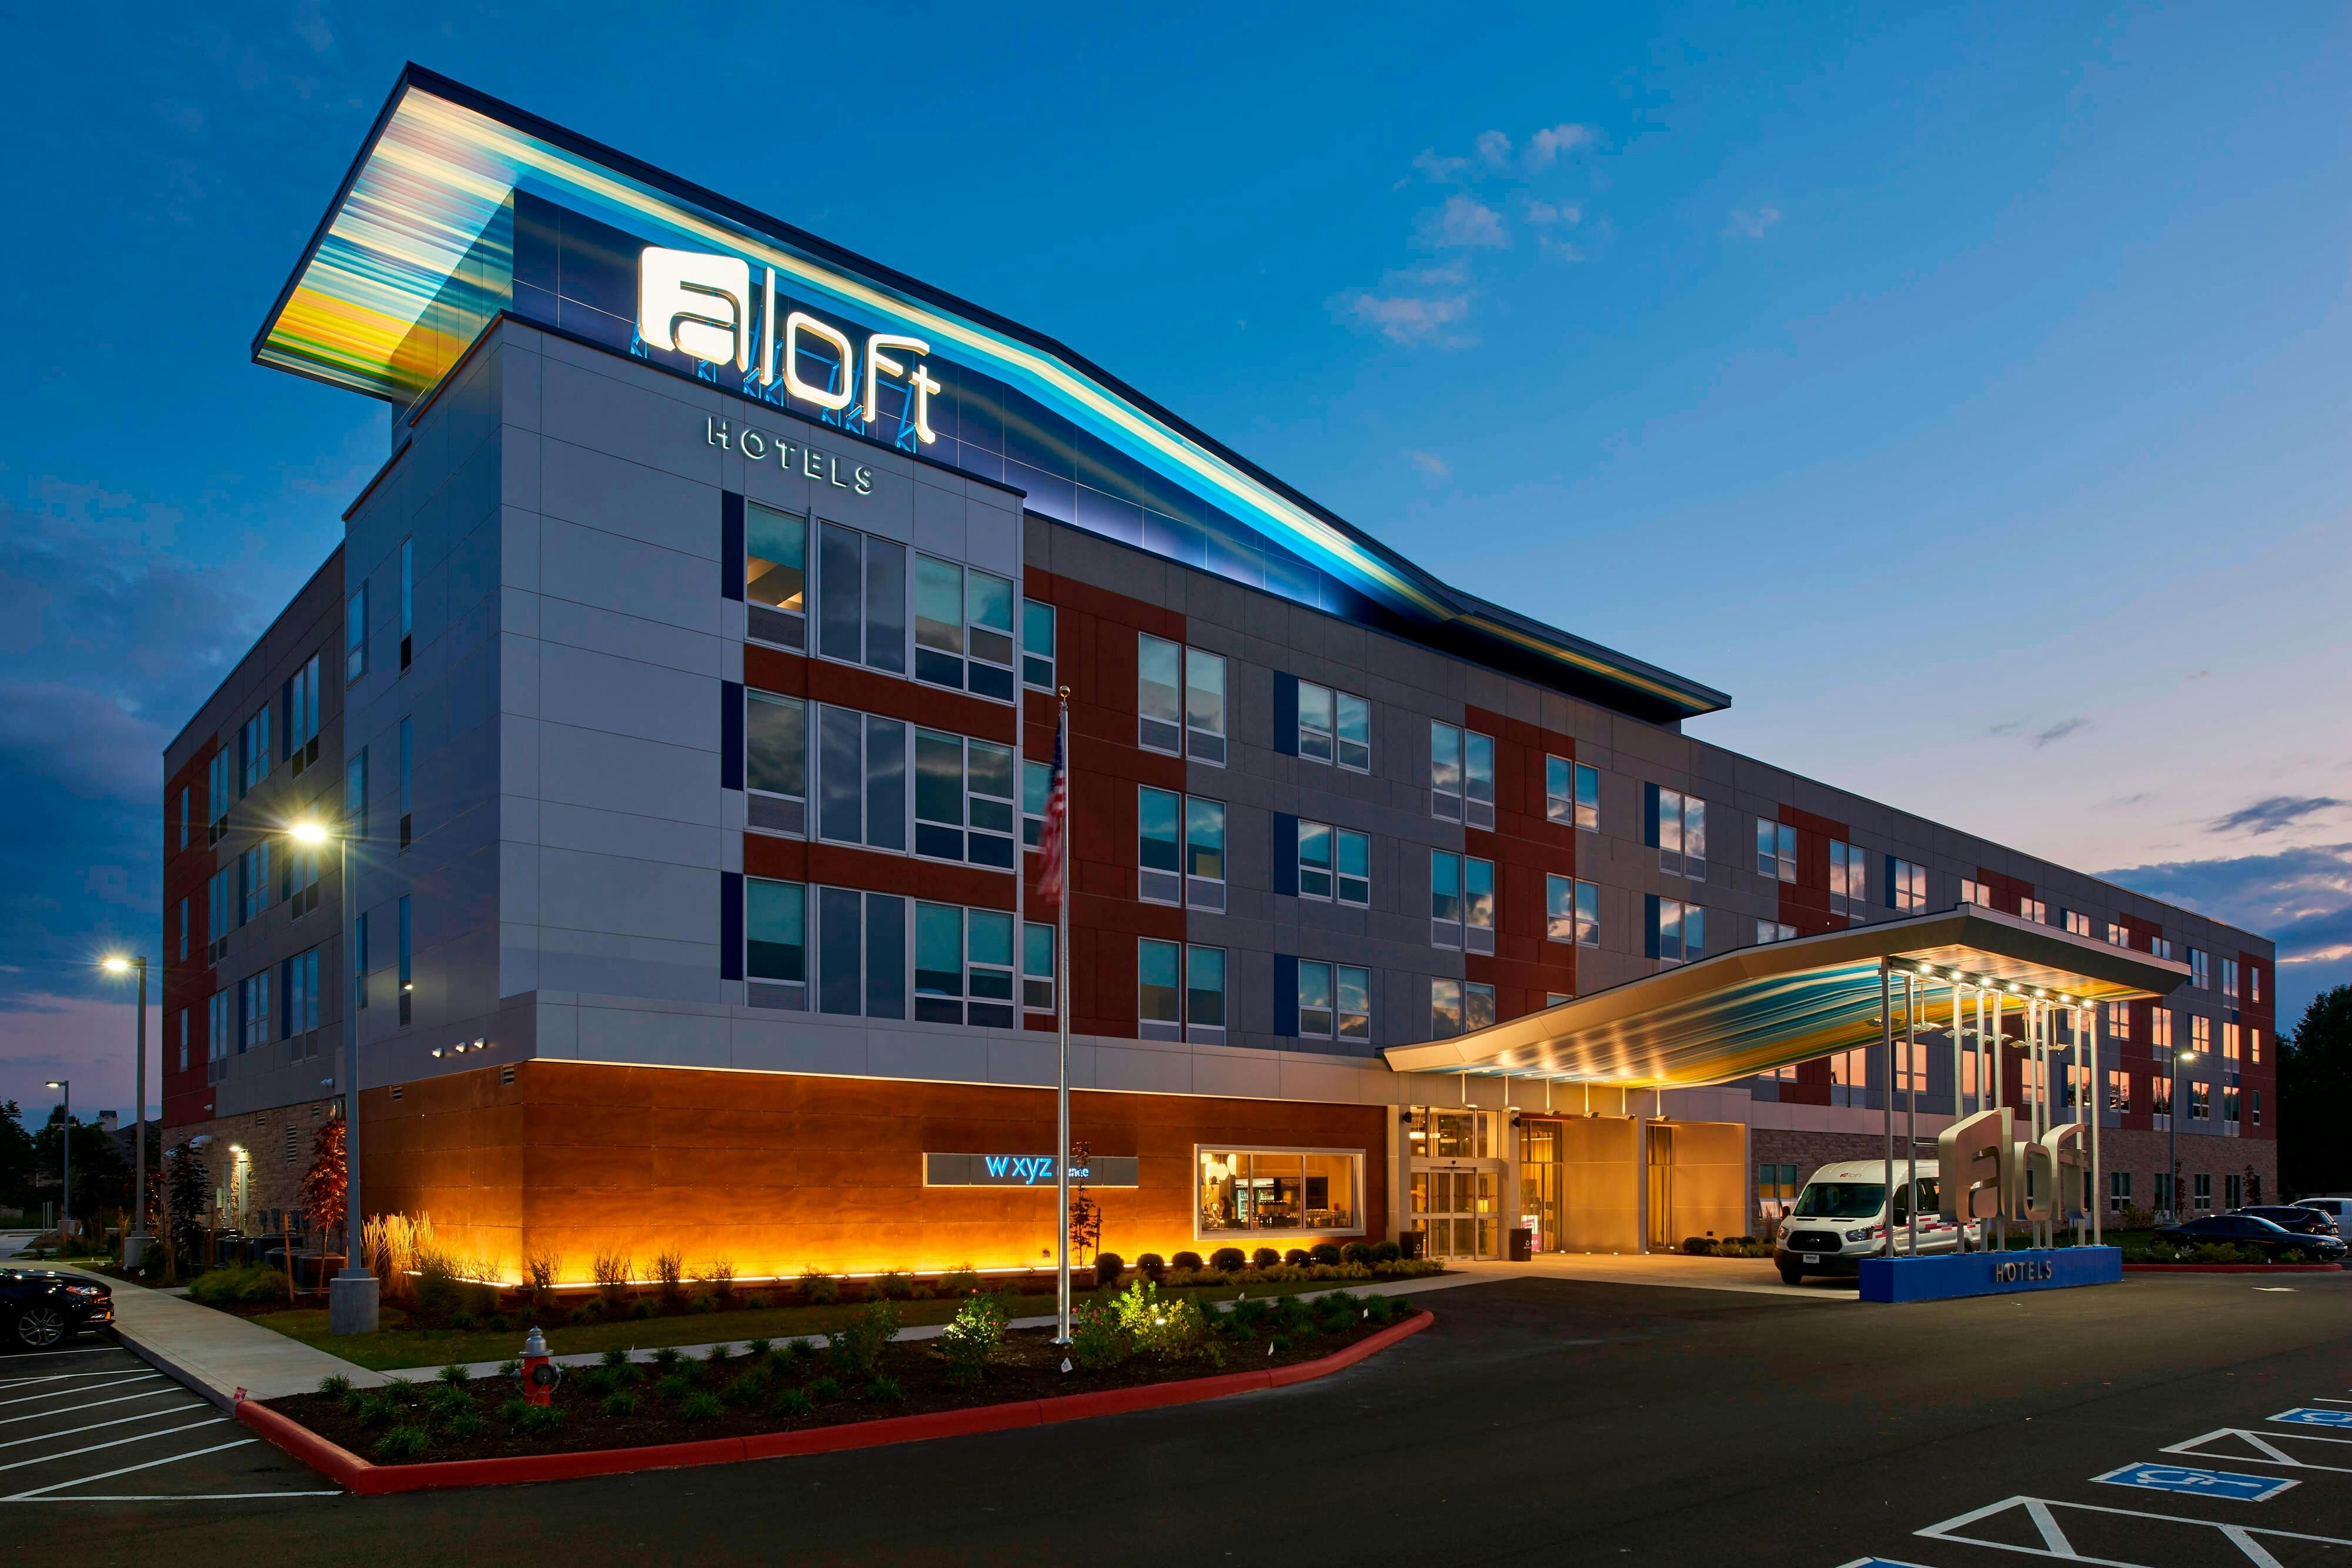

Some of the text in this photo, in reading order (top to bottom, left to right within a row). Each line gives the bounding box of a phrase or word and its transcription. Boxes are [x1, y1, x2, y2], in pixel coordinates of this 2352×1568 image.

[637, 246, 941, 444] aloft
[708, 415, 874, 495] HOTELS
[1938, 1107, 2090, 1223] aloft
[1996, 1260, 2052, 1283] HOTELS
